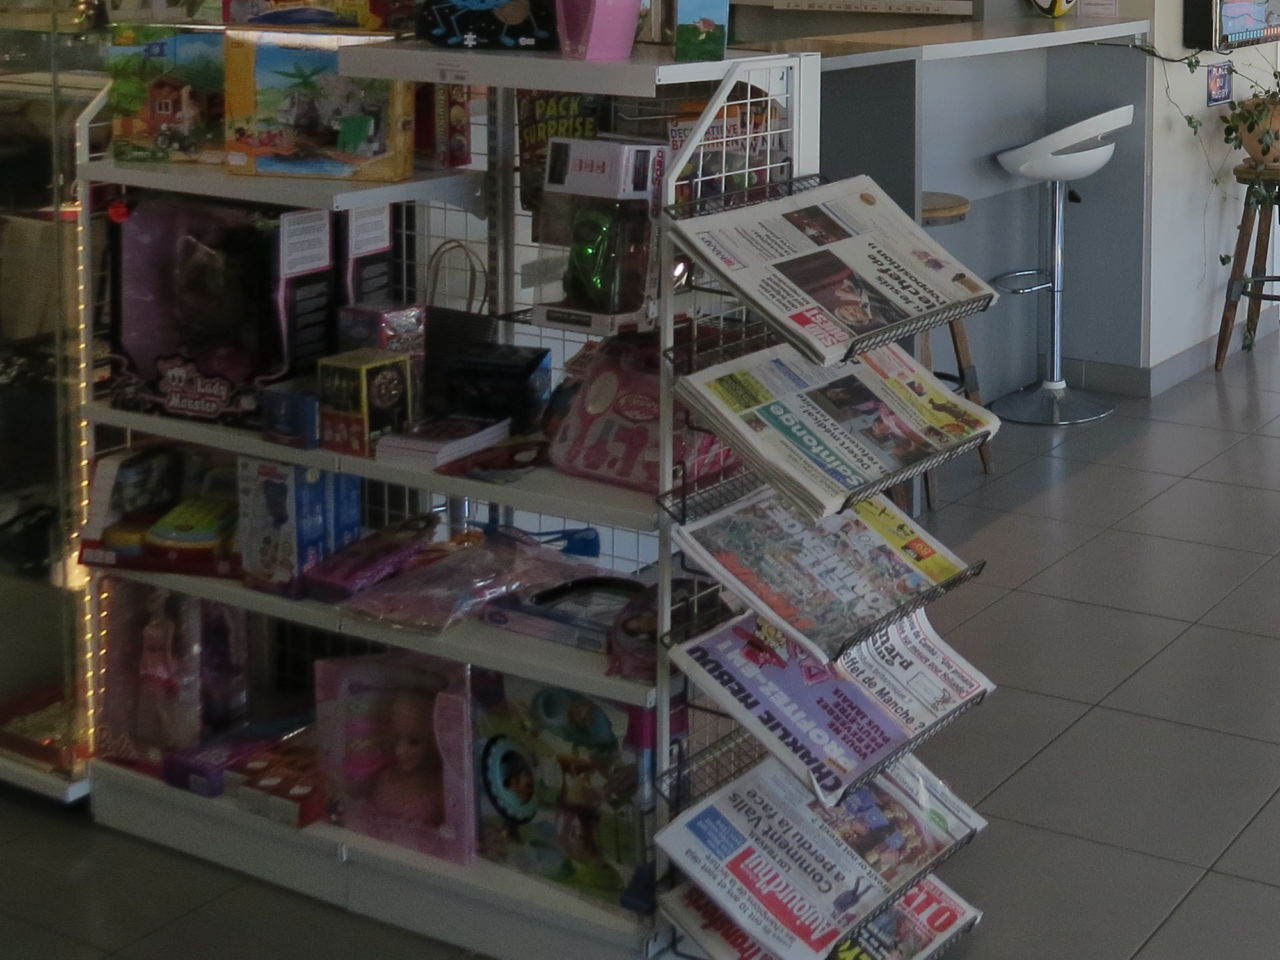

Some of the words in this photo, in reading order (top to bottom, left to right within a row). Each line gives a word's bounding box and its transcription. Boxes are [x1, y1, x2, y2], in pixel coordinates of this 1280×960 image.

[535, 95, 581, 121] PACK
[523, 116, 596, 148] SURPRISE
[671, 124, 738, 139] DECATIEVE
[864, 253, 884, 266] de
[872, 248, 947, 305] l'opposition
[873, 275, 900, 295] suis
[875, 265, 920, 297] chef
[915, 295, 937, 309] le
[802, 307, 851, 341] OUEST
[802, 322, 838, 346] SUD
[799, 409, 841, 441] médical
[765, 403, 866, 487] Saintonge
[835, 441, 872, 470] Désert
[878, 629, 914, 670] nard
[841, 650, 865, 676] effet
[861, 673, 880, 689] de
[874, 686, 917, 723] Manche
[814, 697, 865, 743] REVERREZ
[831, 688, 869, 721] JAMAIS
[839, 733, 869, 759] VOUS
[866, 719, 892, 743] PLUS
[756, 710, 844, 795] CHARLIE
[724, 791, 765, 828] Valls
[743, 788, 779, 819] face
[774, 817, 792, 834] la
[816, 823, 843, 849] Brexit
[746, 830, 778, 859] TRAVAIL
[758, 824, 834, 895] Comment
[787, 830, 836, 873] perdu
[737, 852, 835, 942] Aujourd'hui
